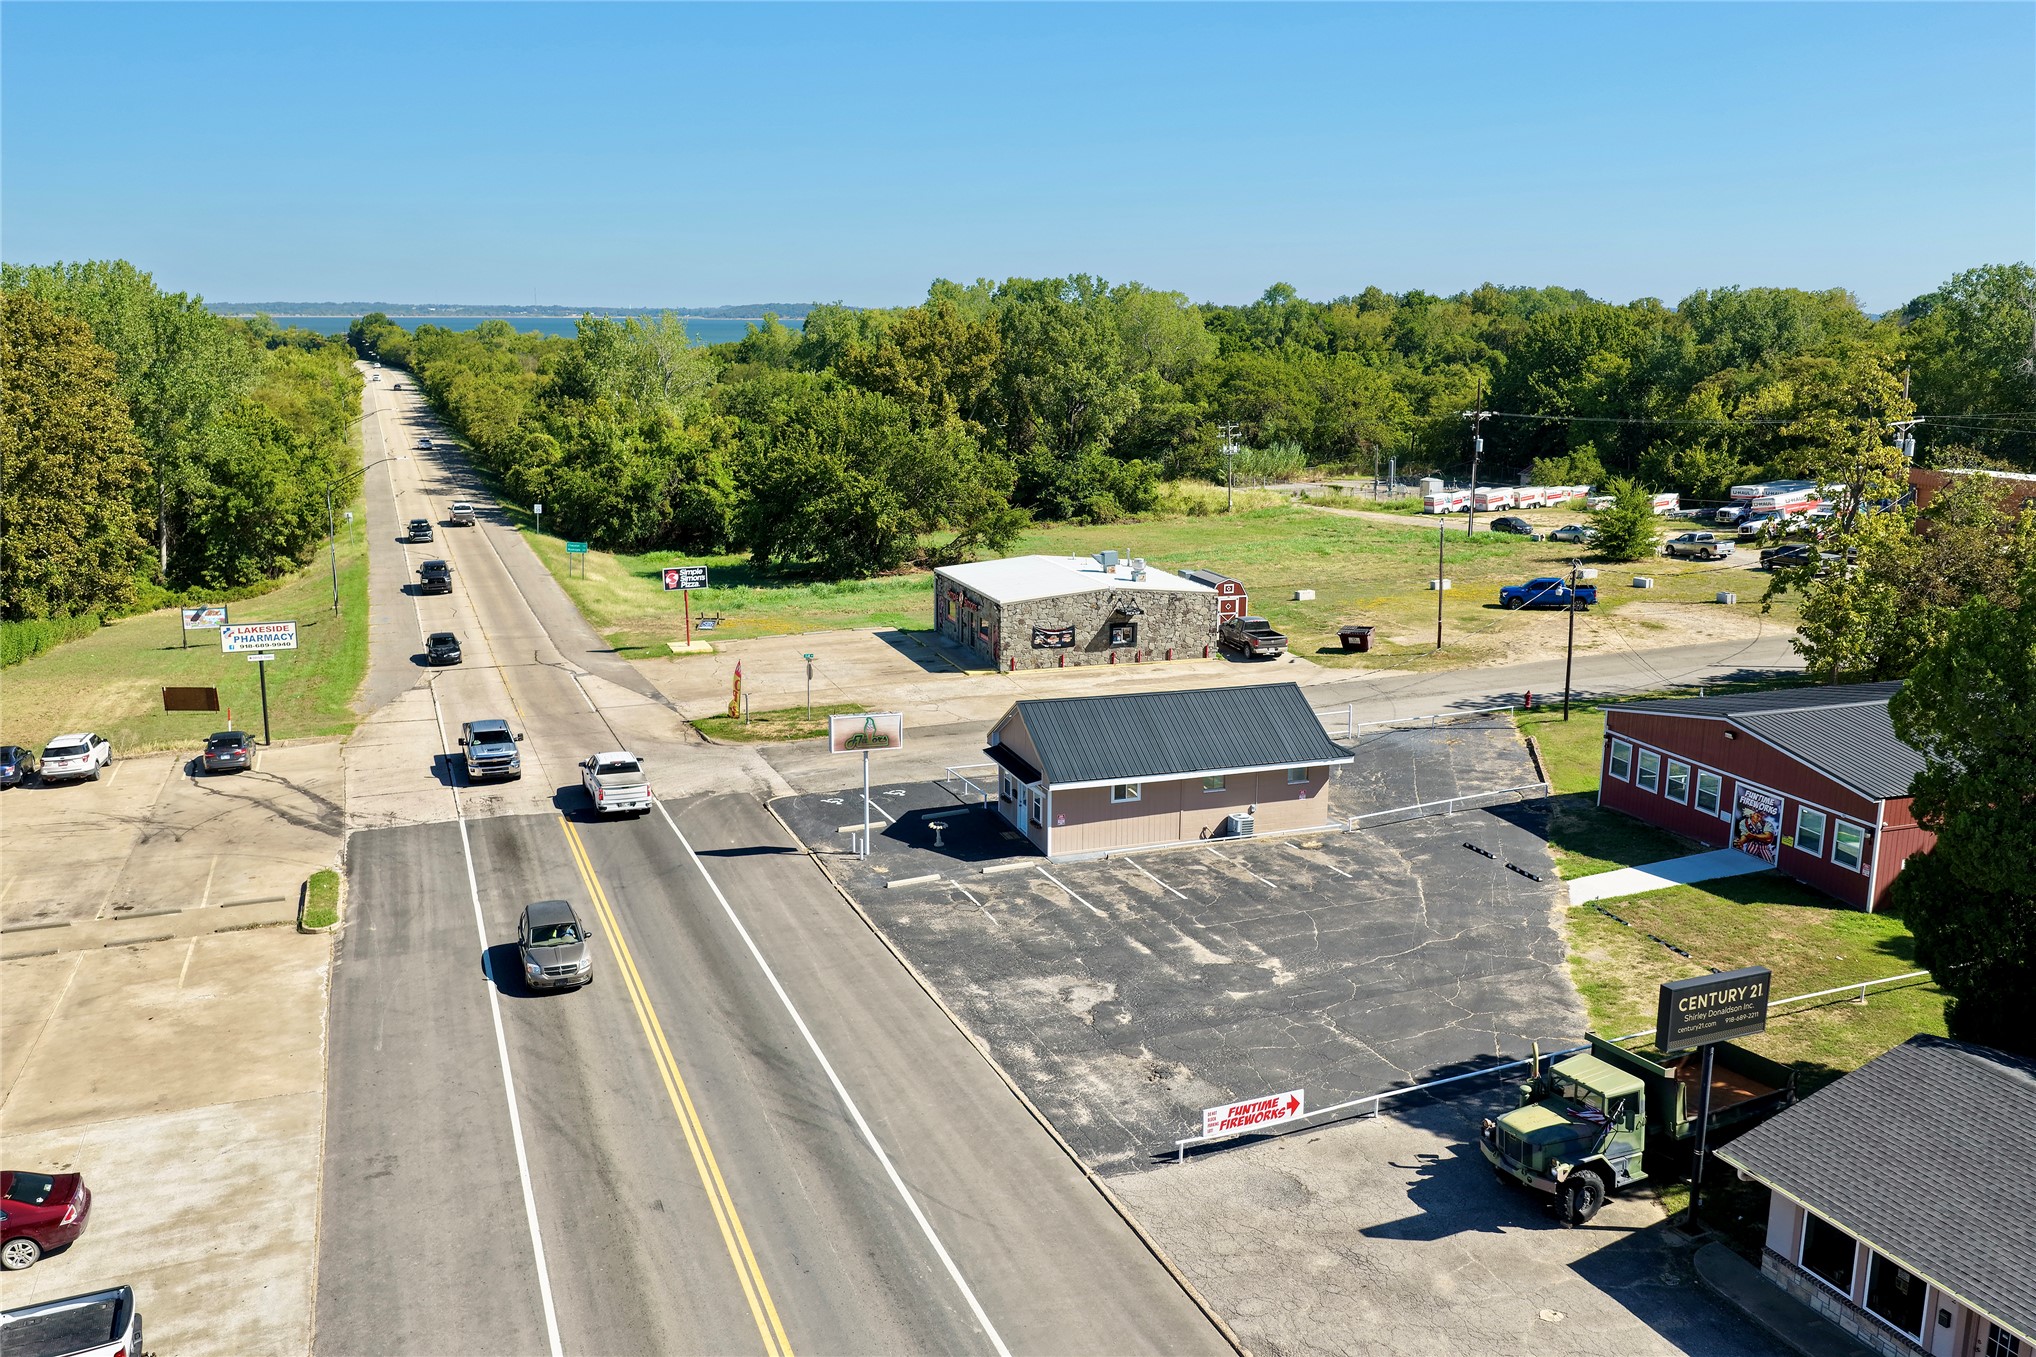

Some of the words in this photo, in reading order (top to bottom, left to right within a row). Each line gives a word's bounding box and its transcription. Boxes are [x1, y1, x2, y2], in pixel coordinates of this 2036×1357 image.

[680, 568, 703, 576] Simple
[237, 624, 290, 635] LAKESIDE
[233, 632, 294, 644] PHARMACY
[1739, 796, 1778, 815] FIREWORKS
[1745, 790, 1775, 806] FUNTIME
[1678, 985, 1748, 1012] CENTURY
[1684, 1012, 1707, 1023] Shirley
[1708, 1005, 1742, 1018] Donaldson
[1725, 1011, 1759, 1023] 918-689-2211
[1677, 1021, 1717, 1034] century21.com
[1227, 1097, 1280, 1118] FUNTIME
[1219, 1107, 1286, 1131] FIREWORKS
